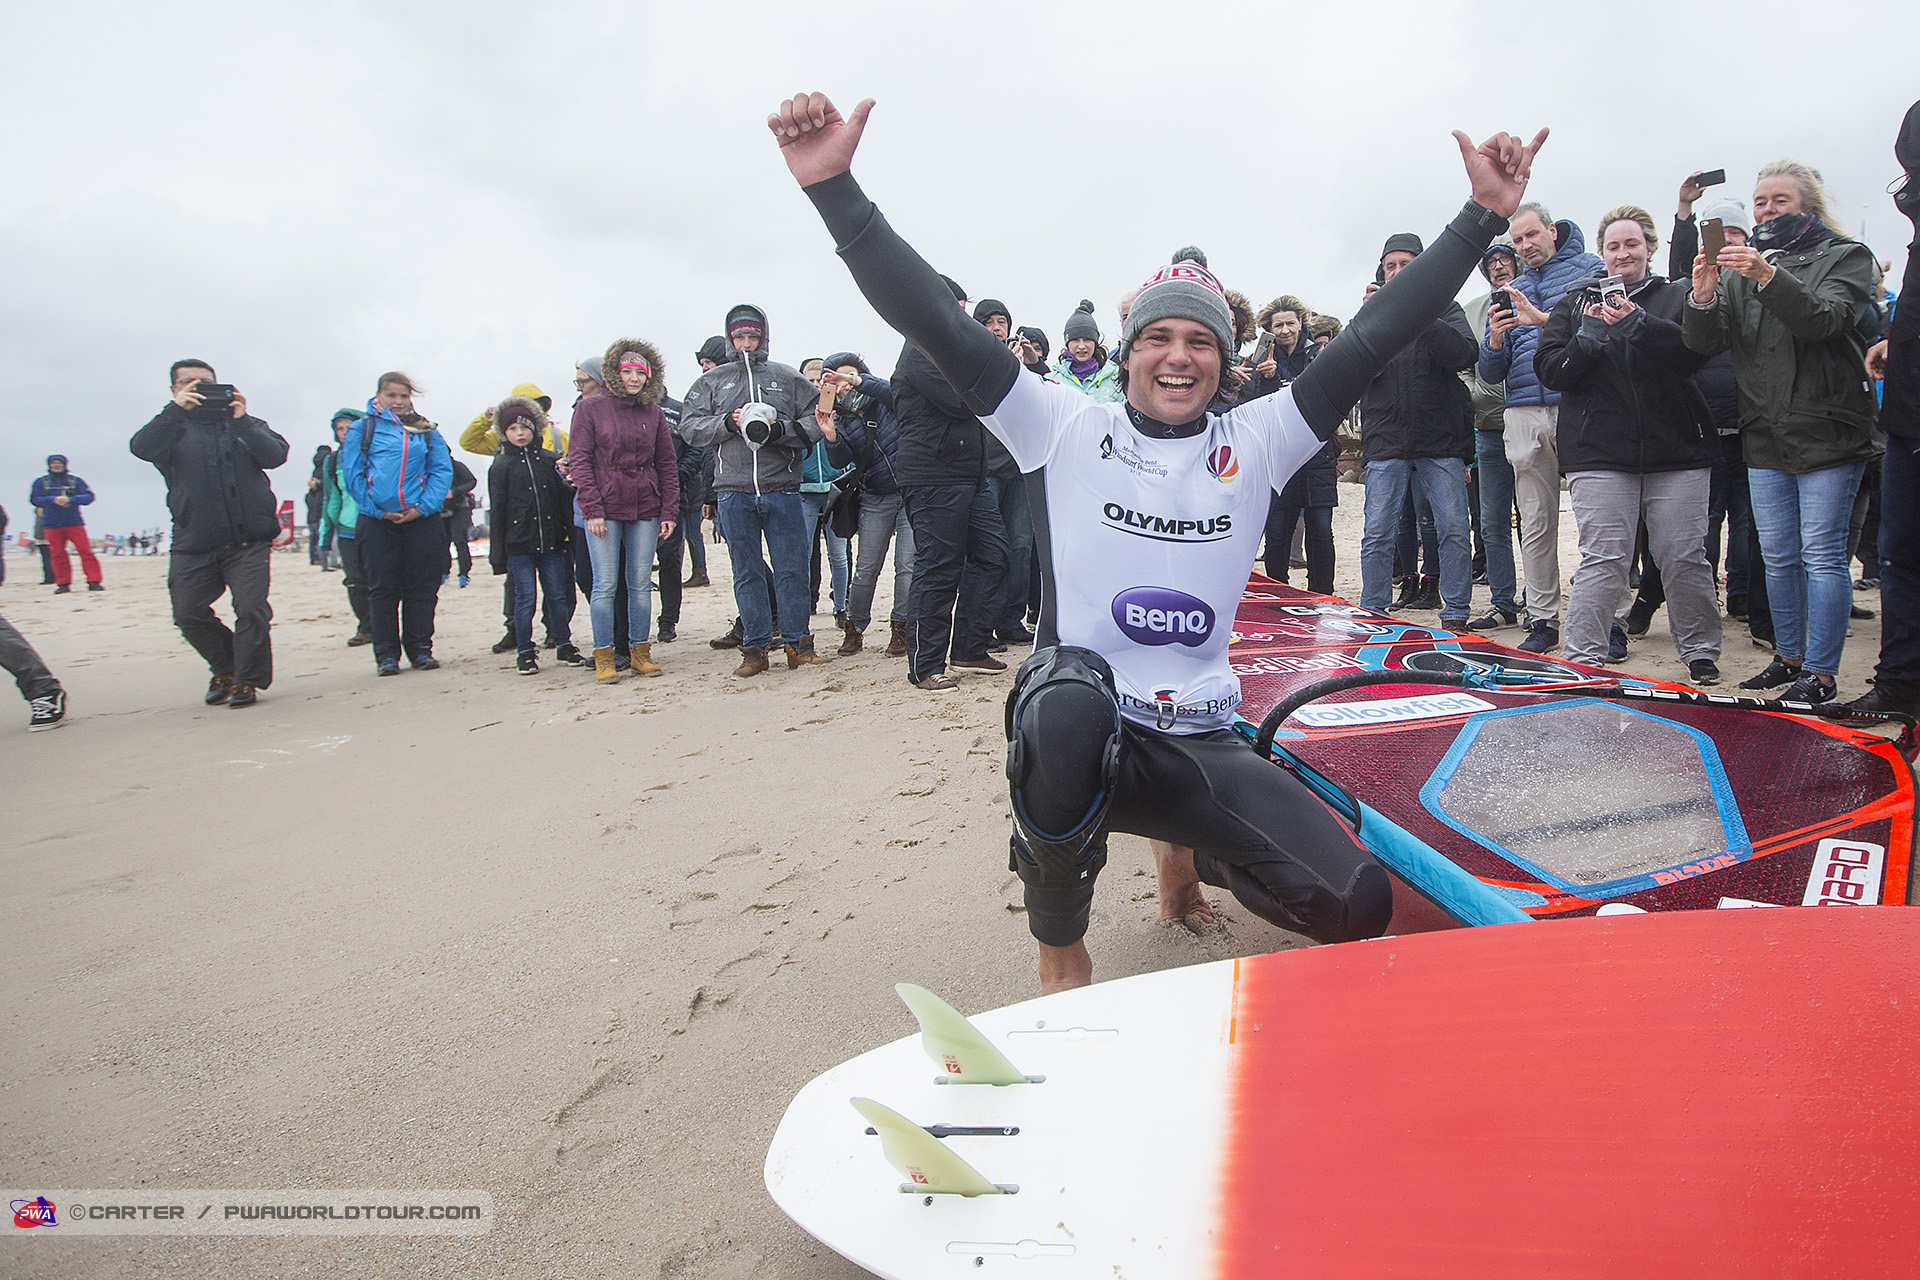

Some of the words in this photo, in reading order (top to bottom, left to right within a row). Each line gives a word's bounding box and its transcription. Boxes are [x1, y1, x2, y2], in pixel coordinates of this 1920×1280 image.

[1103, 502, 1232, 535] OLYMPUS
[1126, 602, 1208, 635] BenQ
[1298, 697, 1482, 722] followfish
[1650, 851, 1741, 886] BLADE
